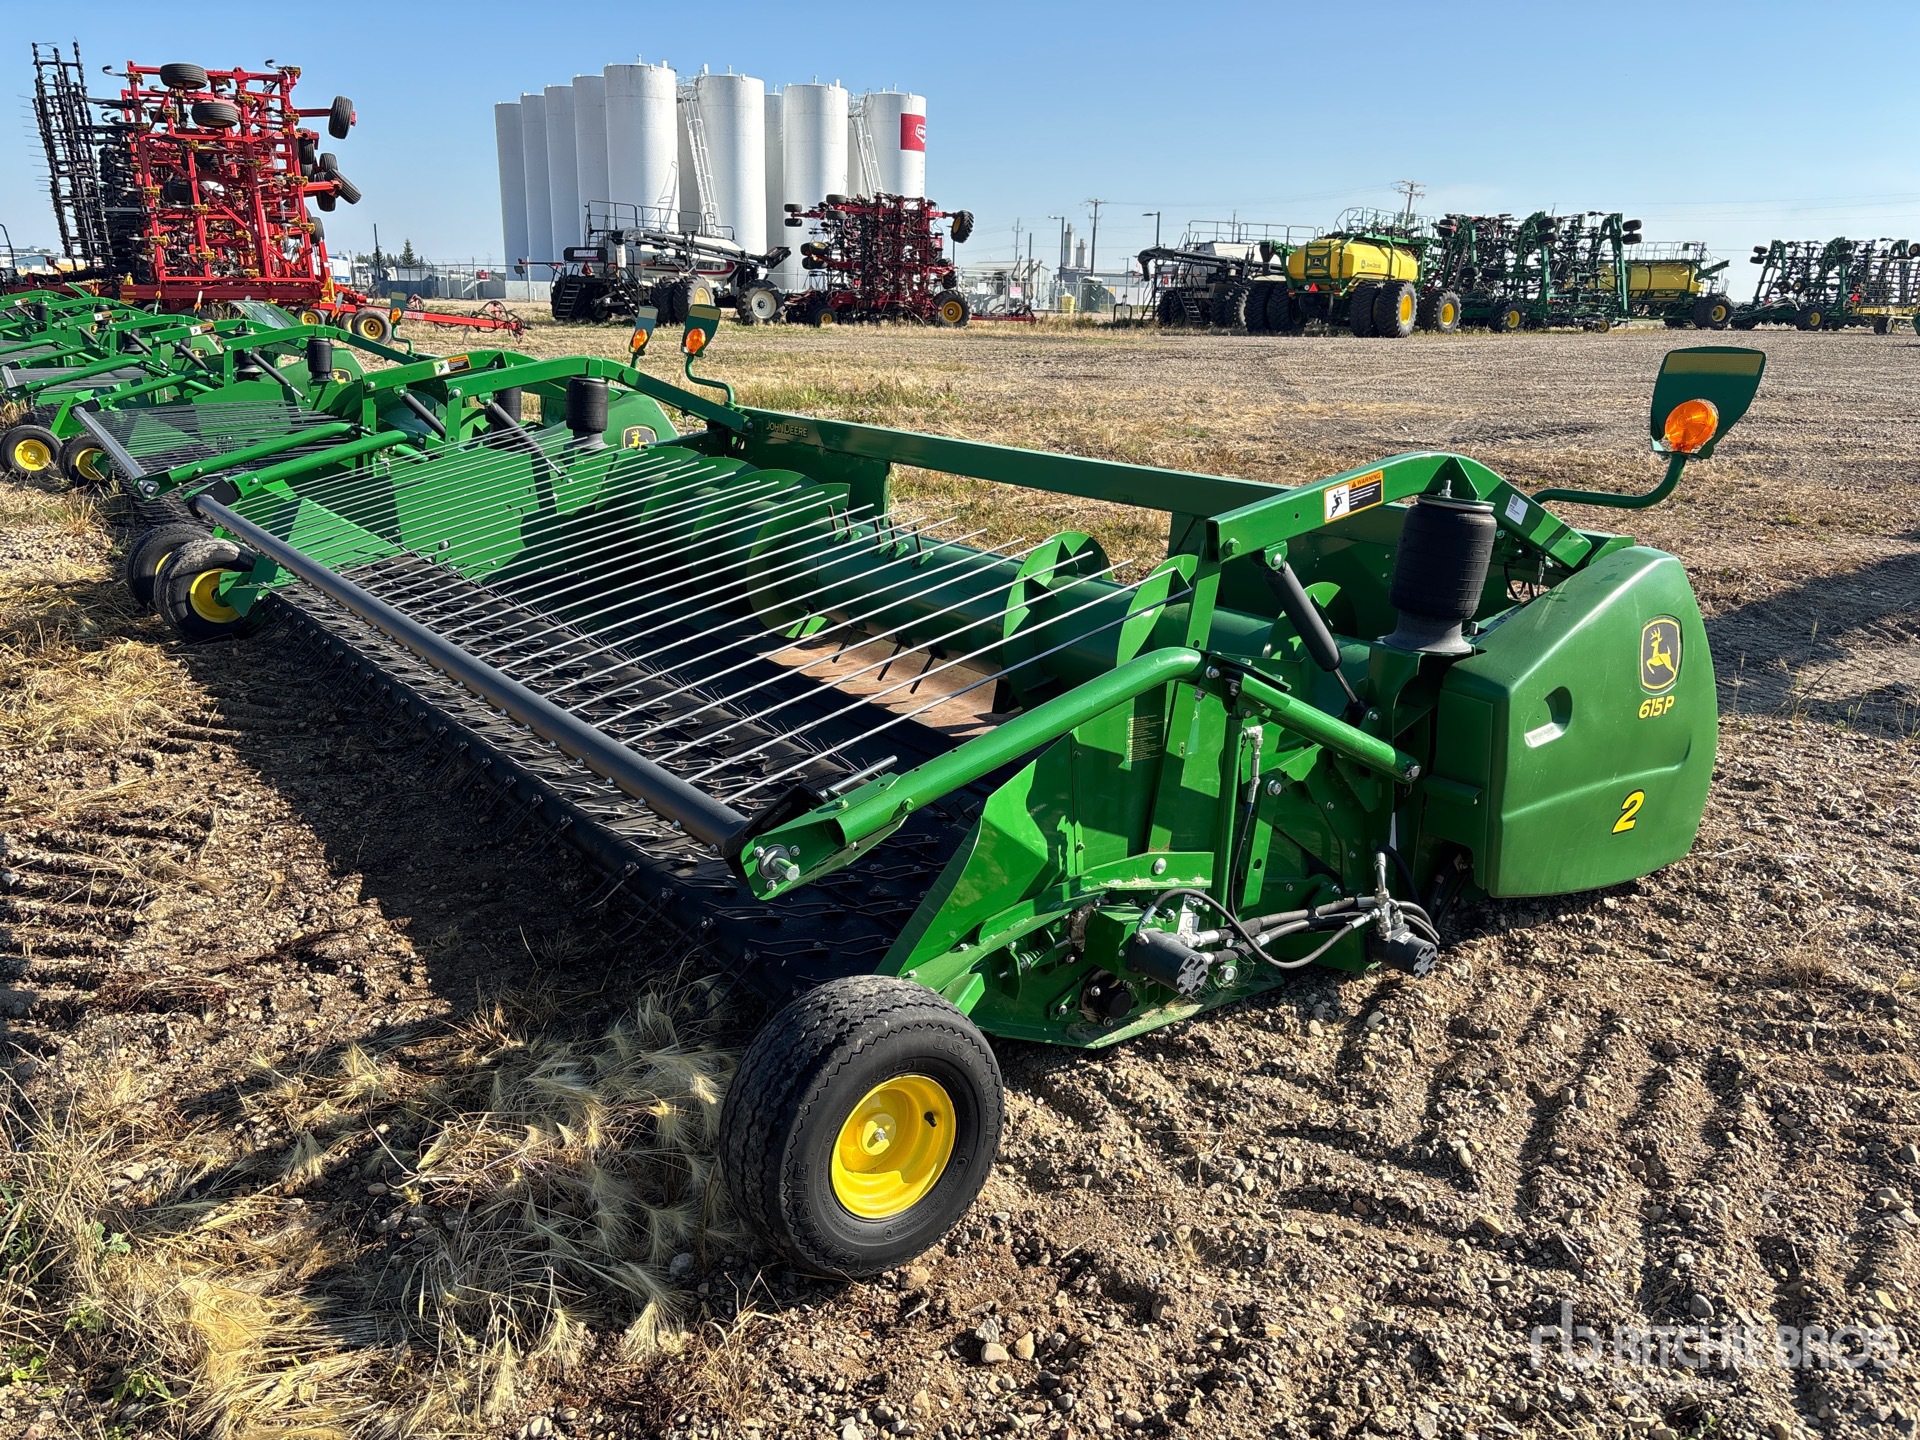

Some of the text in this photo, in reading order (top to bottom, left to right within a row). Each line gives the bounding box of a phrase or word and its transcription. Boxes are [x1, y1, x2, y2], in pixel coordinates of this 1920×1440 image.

[1357, 472, 1380, 485] WARNING
[1638, 695, 1675, 719] 615P
[1612, 789, 1645, 835] 2
[933, 1034, 997, 1149] USA TRAIL
[792, 1161, 861, 1267] CARLISLE
